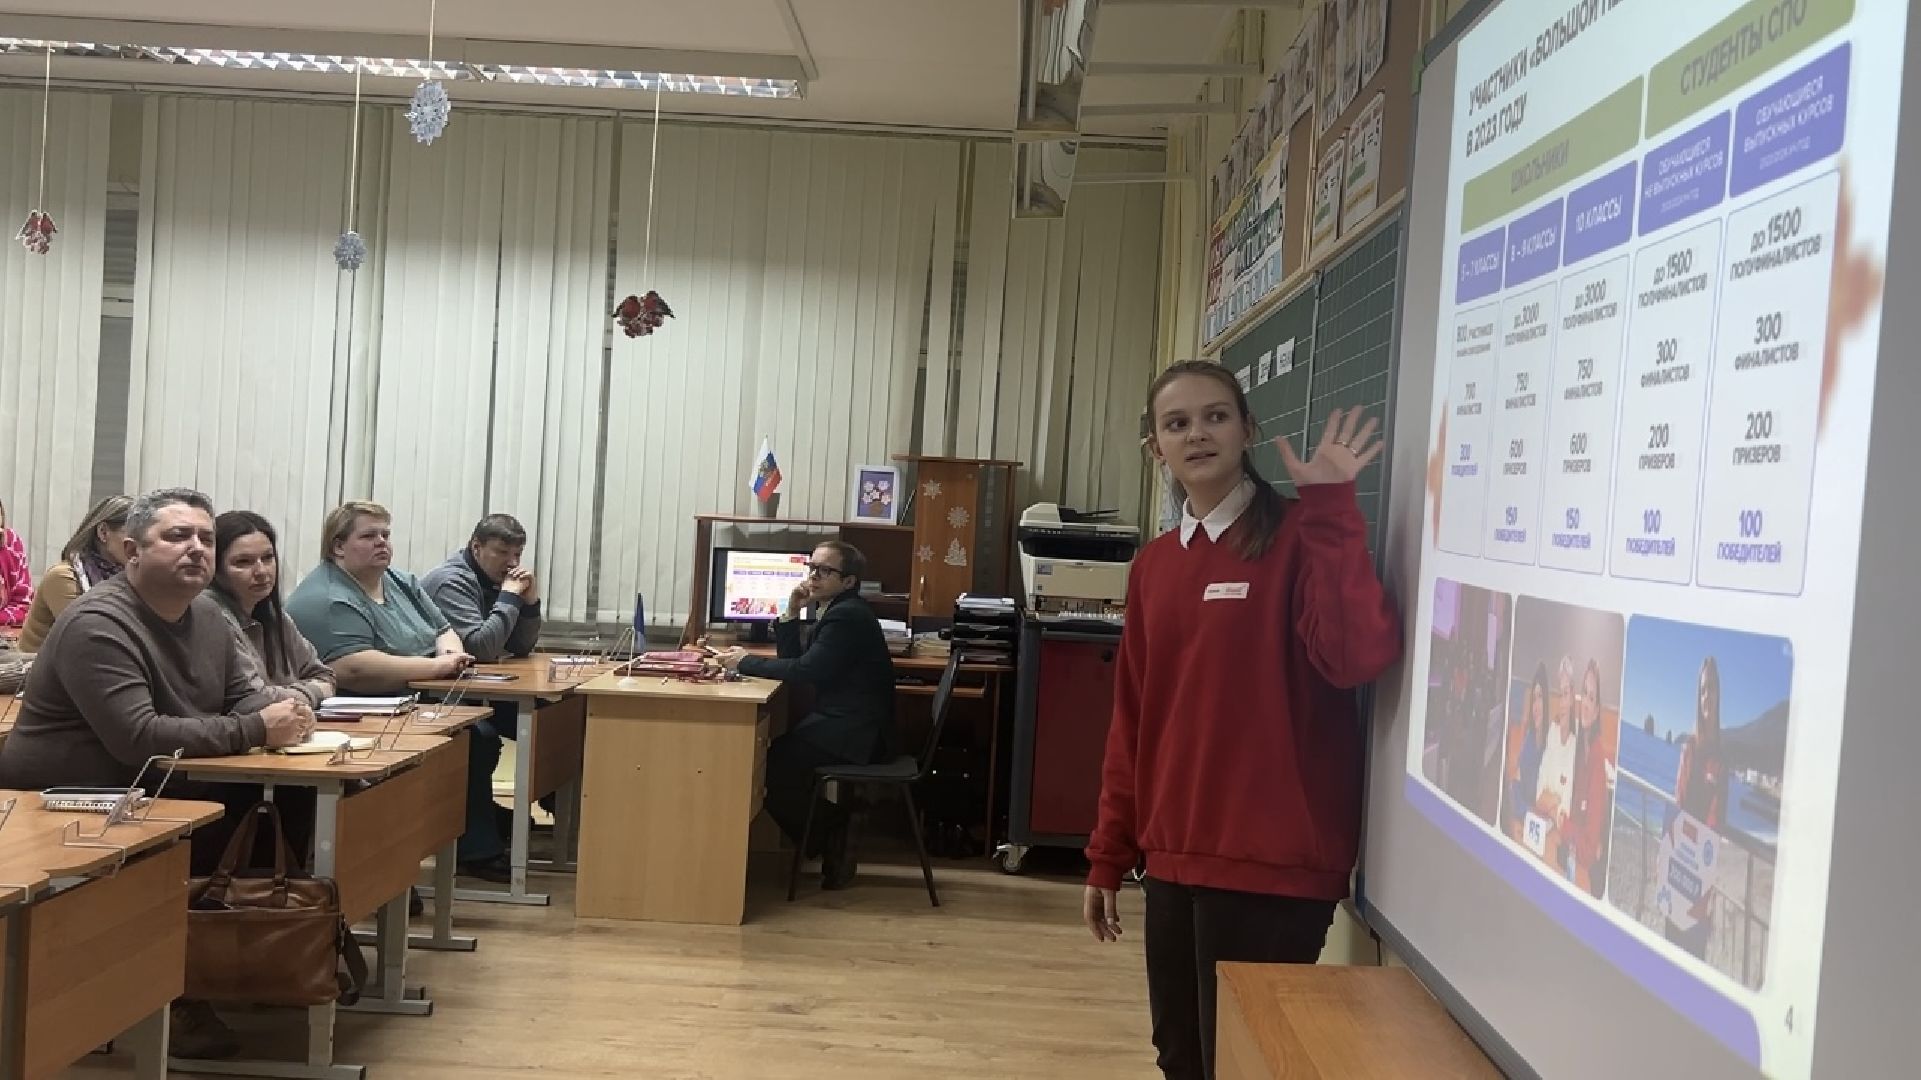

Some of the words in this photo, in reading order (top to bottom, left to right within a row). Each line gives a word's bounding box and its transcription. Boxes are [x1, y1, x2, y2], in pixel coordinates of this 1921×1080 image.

[1680, 15, 1765, 96] СТУДЕНТЫ
[1768, 0, 1808, 42] СПО
[1469, 47, 1528, 116] УЧАСТНИКИ
[1755, 75, 1824, 126] ОБУЧАЮЩИЕСЯ
[1466, 129, 1474, 157] В
[1475, 112, 1498, 152] 2023
[1498, 91, 1528, 136] ГОДУ
[1744, 114, 1796, 153] ВЫПУСКНЫХ
[1797, 94, 1835, 126] КУРСОВ
[1511, 139, 1570, 194] ШКОЛЬНИКИ
[1658, 136, 1711, 176] ОБУЧАЮЩИЕСЯ
[1695, 150, 1724, 176] КУРСОВ
[1576, 214, 1586, 234] 10
[1586, 194, 1623, 229] КЛАССЫ
[1526, 226, 1558, 256] КЛАССЫ
[1751, 229, 1765, 254] до
[1768, 206, 1802, 246] 1500
[1653, 266, 1665, 285] до
[1667, 248, 1693, 279] 1500
[1730, 233, 1823, 281] ПОЛУФИНАЛИСТОВ
[1584, 281, 1606, 306] 3000
[1638, 272, 1708, 309] ПОЛУФИНАЛИСТОВ
[1754, 311, 1782, 345] 300
[1656, 338, 1677, 365] 300
[1735, 342, 1799, 370] ФИНАЛИСТОВ
[1577, 358, 1593, 381] 750
[1641, 363, 1690, 388] ФИНАЛИСТОВ
[1648, 423, 1669, 449] 200
[1745, 411, 1772, 440] 200
[1570, 432, 1587, 454] 600
[1732, 444, 1781, 466] ПРИЗЕРОВ
[1638, 453, 1675, 470] ПРИЗЕРОВ
[1505, 506, 1518, 526] 150
[1566, 507, 1580, 529] 150
[1643, 509, 1661, 534] 100
[1739, 509, 1763, 538] 100
[1626, 537, 1675, 557] ПОБЕДИТЕЛЕЙ
[1717, 541, 1782, 563] ПОБЕДИТЕЛЕЙ
[1784, 1005, 1794, 1034] 4
